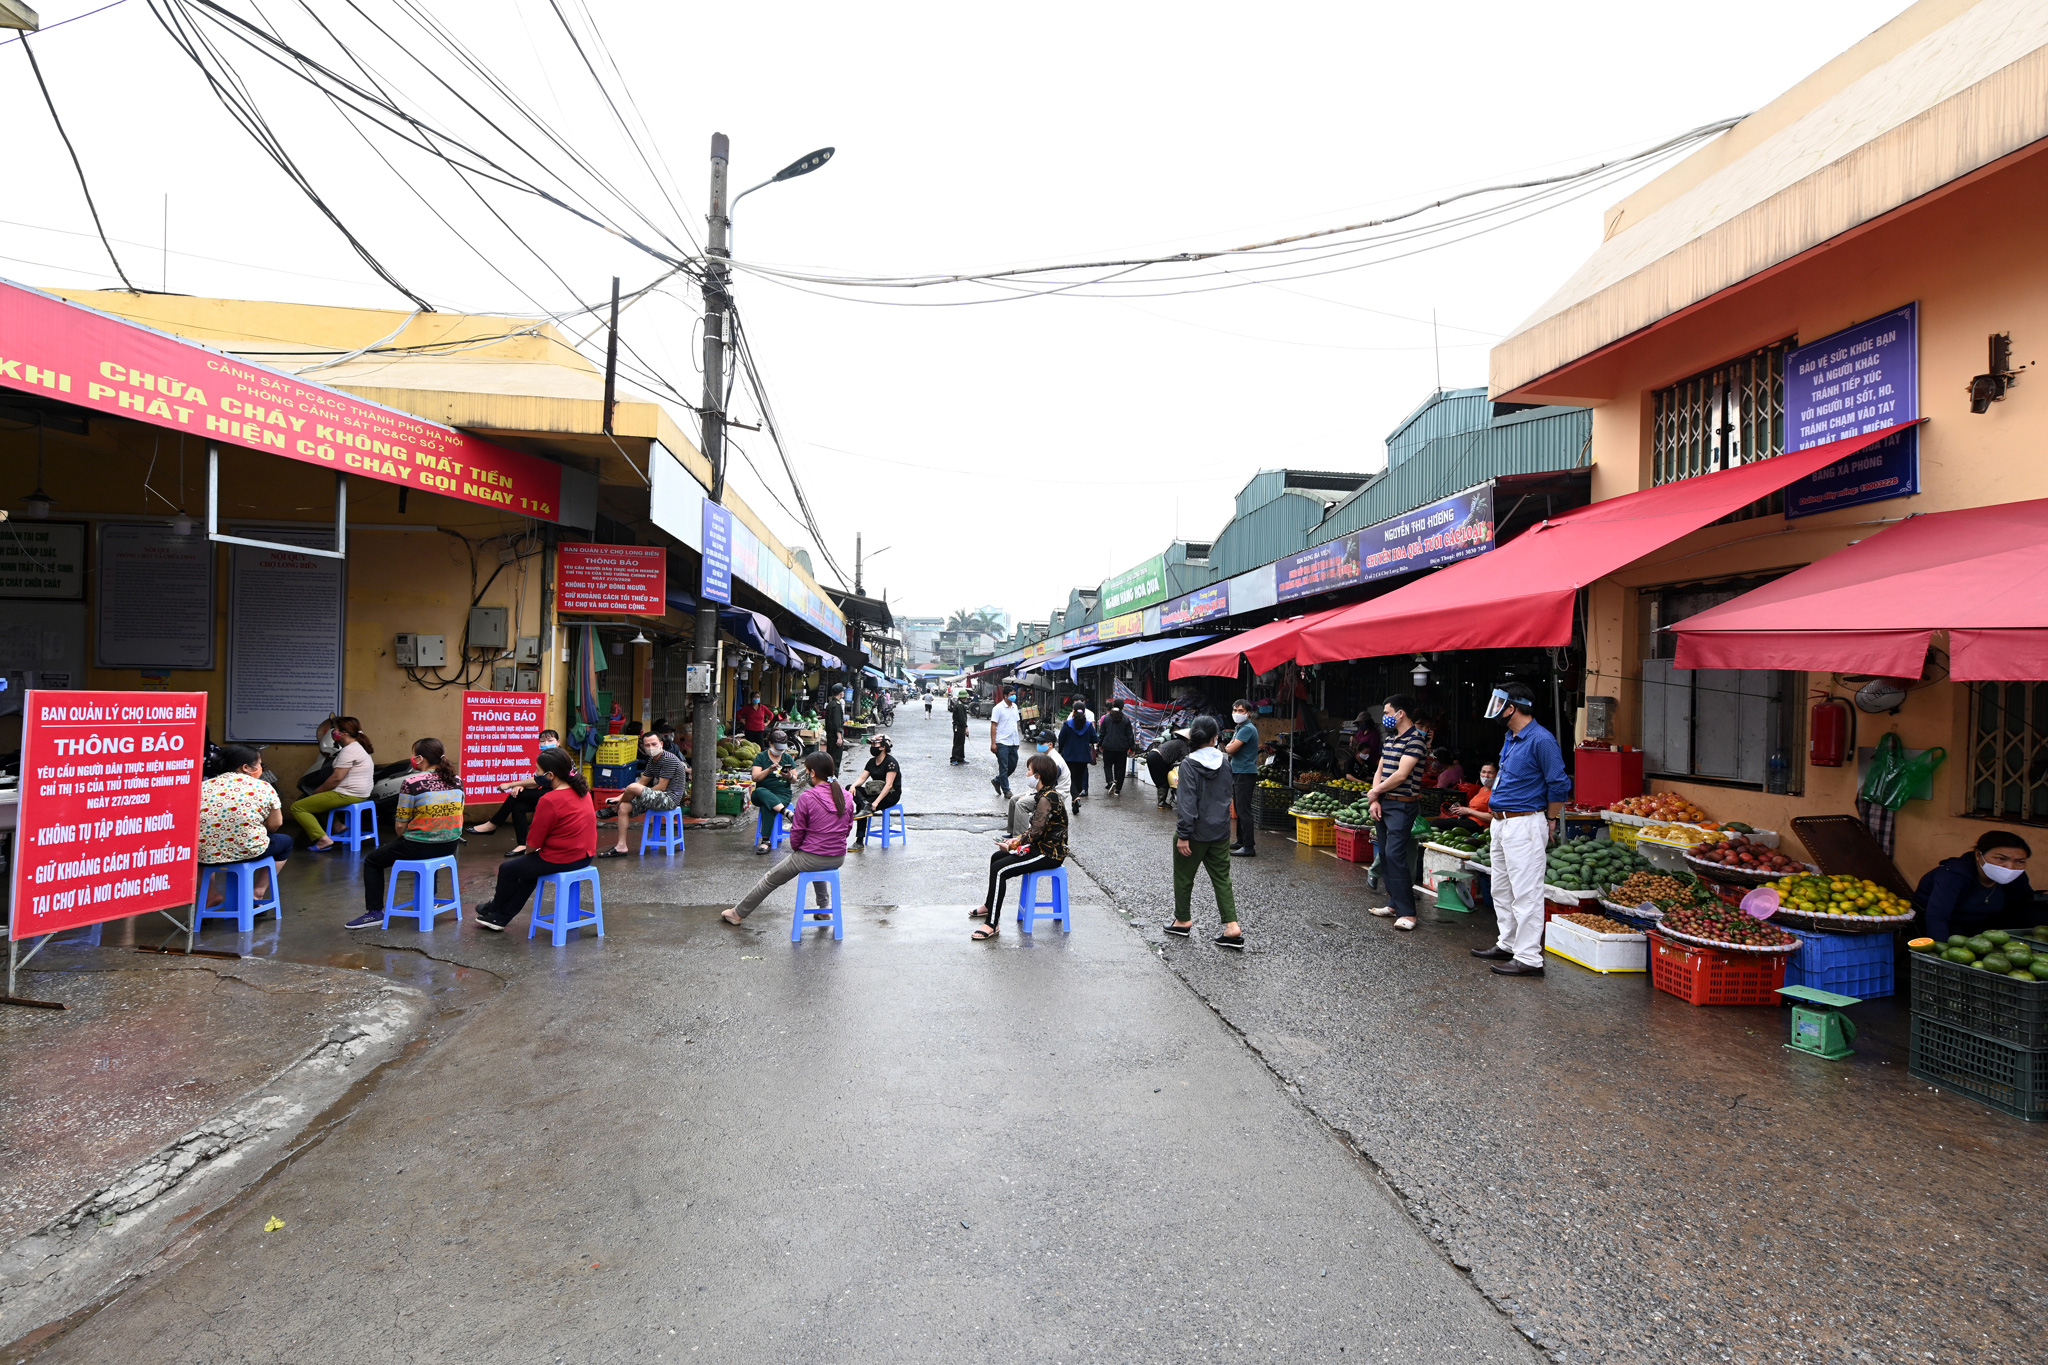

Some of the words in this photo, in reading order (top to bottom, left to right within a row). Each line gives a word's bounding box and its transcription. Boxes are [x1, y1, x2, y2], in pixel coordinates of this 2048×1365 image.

[1799, 358, 1816, 375] BẢO
[1818, 354, 1828, 369] VỆ
[1830, 348, 1848, 364] SỨC
[1850, 337, 1874, 357] KHỎE
[1876, 330, 1896, 348] BẠN
[1813, 371, 1824, 386] VÀ
[1826, 361, 1853, 382] NGƯỜI
[1855, 353, 1880, 371] KHÁC
[1812, 384, 1839, 402] TRÁNH
[1841, 374, 1861, 393] TIẾP
[1863, 370, 1882, 386] XÚC
[207, 360, 255, 382] CẢNH
[260, 377, 291, 393] SÁT
[295, 388, 346, 411] PC&CC
[350, 405, 394, 426] THÀNH
[398, 420, 423, 434] PHỐ
[426, 429, 442, 441] HÀ
[445, 435, 463, 447] NỘI
[1801, 407, 1815, 422] VỚI
[1816, 398, 1843, 417] NGƯỜI
[1845, 396, 1854, 408] BỊ
[1856, 387, 1877, 405] SỐT,
[1878, 384, 1895, 398] HO.
[100, 361, 208, 406] CHỮA
[220, 396, 306, 432] CHÁY
[316, 423, 408, 461] KHÔNG
[415, 452, 464, 475] MẤT
[469, 467, 513, 489] TIỀN
[237, 383, 294, 408] PHÒNG
[298, 403, 340, 422] CẢNH
[343, 416, 370, 430] SÁT
[373, 425, 417, 444] PC&CC
[420, 439, 436, 451] SỐ
[438, 444, 445, 453] 2
[1800, 420, 1827, 438] TRÁNH
[1829, 411, 1856, 428] CHẠM
[1857, 405, 1876, 421] VÀO
[1878, 399, 1896, 415] TAY
[0, 357, 71, 393] KHI
[88, 382, 194, 424] PHÁT
[206, 414, 286, 449] HIỆN
[296, 440, 335, 461] CÓ
[344, 452, 412, 480] CHÁY
[419, 471, 457, 491] GỌI
[463, 482, 514, 505] NGAY
[519, 497, 551, 514] 114
[1883, 432, 1901, 448] TAY
[1837, 462, 1851, 476] XÀ
[1851, 455, 1883, 473] PHÒNG
[1860, 476, 1899, 493] 19003228
[1384, 520, 1410, 541] NGUYỄN
[1411, 519, 1426, 534] THU
[1427, 508, 1455, 528] HƯƠNG
[288, 553, 307, 562] QUY
[1366, 548, 1391, 568] CHUYÊN
[1392, 546, 1407, 562] HOA
[1407, 536, 1424, 560] QUẢ
[1424, 534, 1443, 553] TƯƠI
[1444, 527, 1461, 547] CÁC
[1461, 521, 1483, 544] LOẠI
[57, 564, 74, 573] SINH
[259, 561, 276, 570] CHỢ
[300, 561, 318, 569] BIÊN
[585, 557, 617, 565] THÔNG
[620, 558, 639, 566] BÁO
[41, 706, 67, 721] BAN
[69, 701, 103, 721] QUẢN
[105, 703, 119, 720] LÝ
[121, 705, 144, 724] CHỢ
[146, 706, 173, 720] LONG
[175, 703, 197, 719] BIÊN
[480, 695, 495, 704] QUẢN
[496, 696, 503, 704] LÝ
[503, 697, 514, 706] CHỢ
[471, 709, 511, 721] THÔNG
[513, 710, 536, 721] BÁO
[54, 733, 134, 756] THÔNG
[141, 731, 184, 752] BÁO
[37, 765, 55, 779] YÊU
[57, 763, 75, 778] CẦU
[77, 762, 103, 776] NGƯỜI
[105, 761, 123, 775] DÂN
[125, 761, 145, 775] THỰC
[146, 759, 164, 774] HIỆN
[165, 758, 194, 771] NGHIÊM
[40, 781, 56, 796] CHỈ
[58, 782, 72, 796] THỊ
[75, 782, 85, 793] 15
[87, 777, 104, 793] CỦA
[106, 772, 122, 791] THỦ
[124, 775, 149, 789] TƯỚNG
[151, 773, 174, 787] CHÍNH
[175, 771, 190, 785] PHỦ
[87, 796, 110, 809] NGÀY
[111, 793, 150, 807] 27/3/2020
[38, 823, 75, 846] KHÔNG
[78, 823, 92, 844] TỤ
[94, 818, 113, 842] TẬP
[115, 815, 142, 836] ĐÔNG
[144, 810, 175, 833] NGƯỜI.
[35, 860, 57, 884] GIỮ
[57, 852, 100, 880] KHOẢNG
[103, 850, 129, 873] CÁCH
[132, 845, 147, 868] TỐI
[149, 841, 175, 865] THIỂU
[177, 845, 190, 861] 2m
[32, 895, 49, 917] TẠI
[52, 889, 76, 912] CHỢ
[77, 884, 91, 906] VÀ
[93, 883, 111, 903] NƠI
[114, 877, 141, 899] CÔNG
[143, 873, 171, 896] CỘNG.
